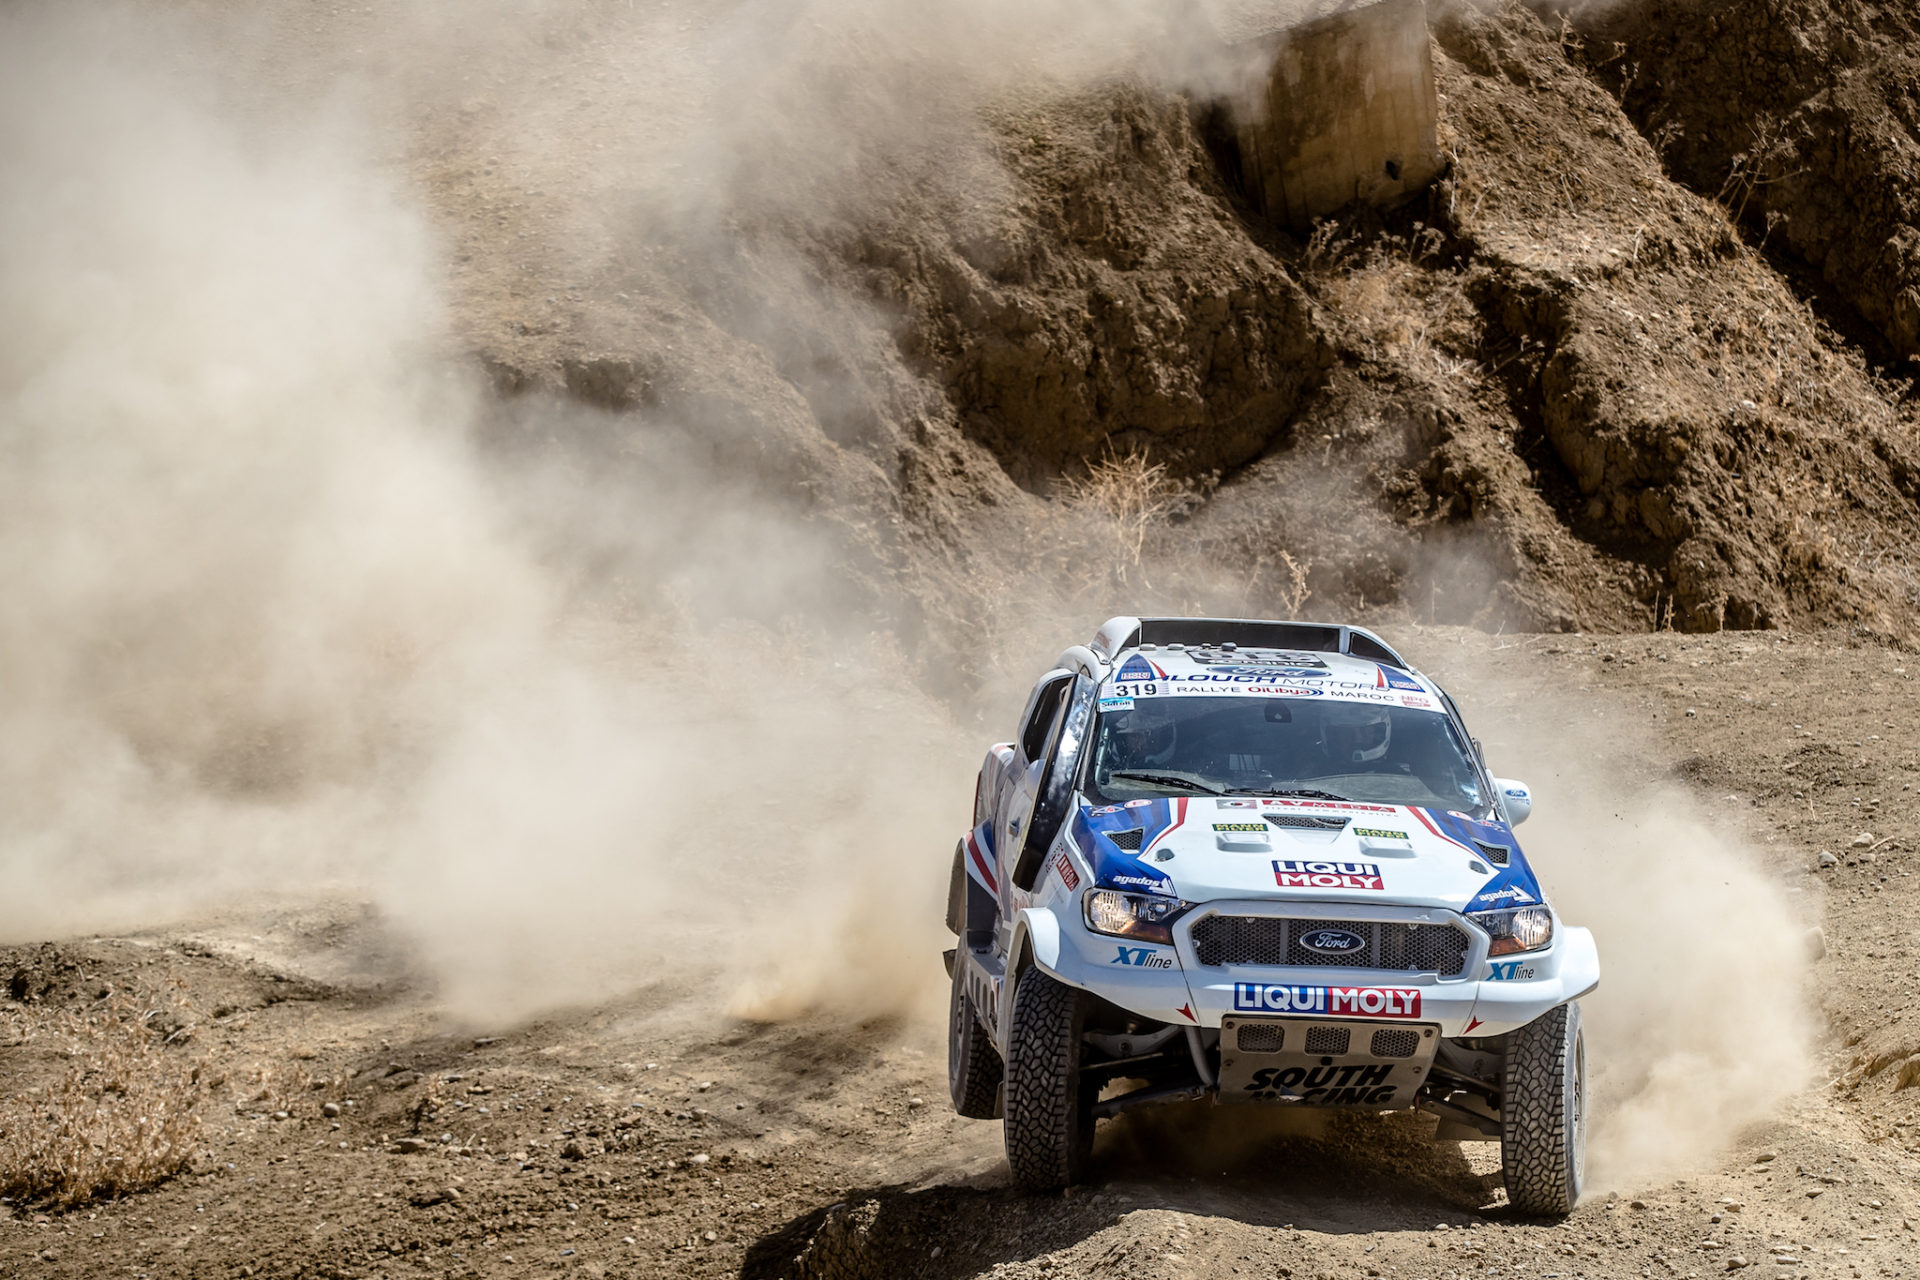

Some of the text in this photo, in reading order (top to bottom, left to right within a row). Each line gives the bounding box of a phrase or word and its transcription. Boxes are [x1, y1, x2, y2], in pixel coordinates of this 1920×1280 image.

[1115, 683, 1157, 697] 319
[1282, 678, 1391, 692] MOTORS
[1330, 690, 1395, 702] MAROC
[1276, 861, 1376, 876] LIQUI
[1112, 875, 1161, 887] agados
[1280, 873, 1380, 889] MOLY
[1478, 889, 1517, 902] agados
[1315, 932, 1350, 949] Ford
[1111, 946, 1172, 969] XTline
[1485, 961, 1534, 981] XTline
[1238, 983, 1421, 1015] LIQUI MOLY
[1243, 1064, 1395, 1091] SOUTH
